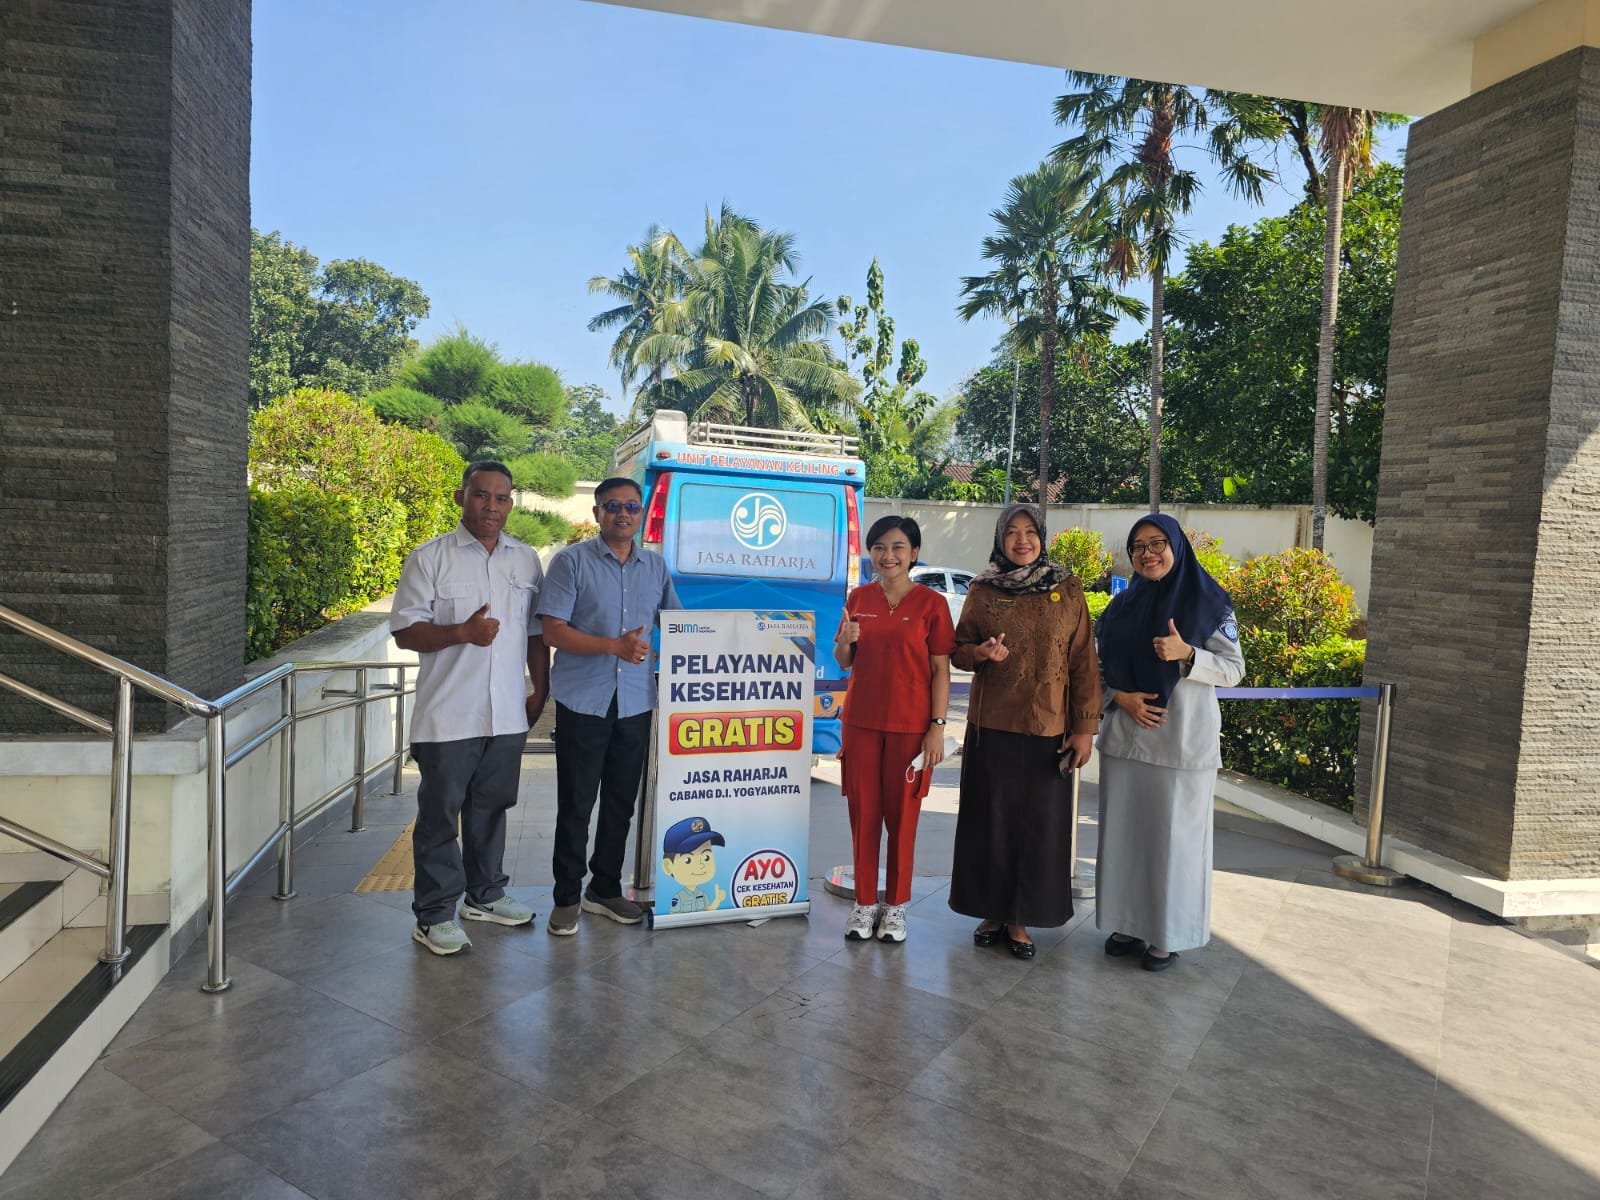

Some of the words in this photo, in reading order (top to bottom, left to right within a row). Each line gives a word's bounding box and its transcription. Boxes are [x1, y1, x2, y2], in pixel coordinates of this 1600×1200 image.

[677, 452, 707, 465] UNIT
[710, 455, 783, 471] PELAYANAN
[786, 461, 839, 476] KELILING
[697, 551, 736, 565] JASA
[741, 554, 816, 570] RAHARJA
[671, 654, 804, 675] PELAYANAN
[670, 681, 802, 703] KESEHATAN
[677, 716, 796, 749] GRATIS
[683, 770, 721, 785] JASA
[723, 766, 788, 782] RAHARJA
[669, 789, 714, 802] CABANG
[715, 788, 732, 798] D.I.
[734, 784, 801, 798] YOGYAKARTA
[743, 857, 786, 881] AYO
[736, 885, 751, 893] CEK
[752, 881, 794, 892] KESEHATAN
[742, 892, 787, 908] GRATIS
